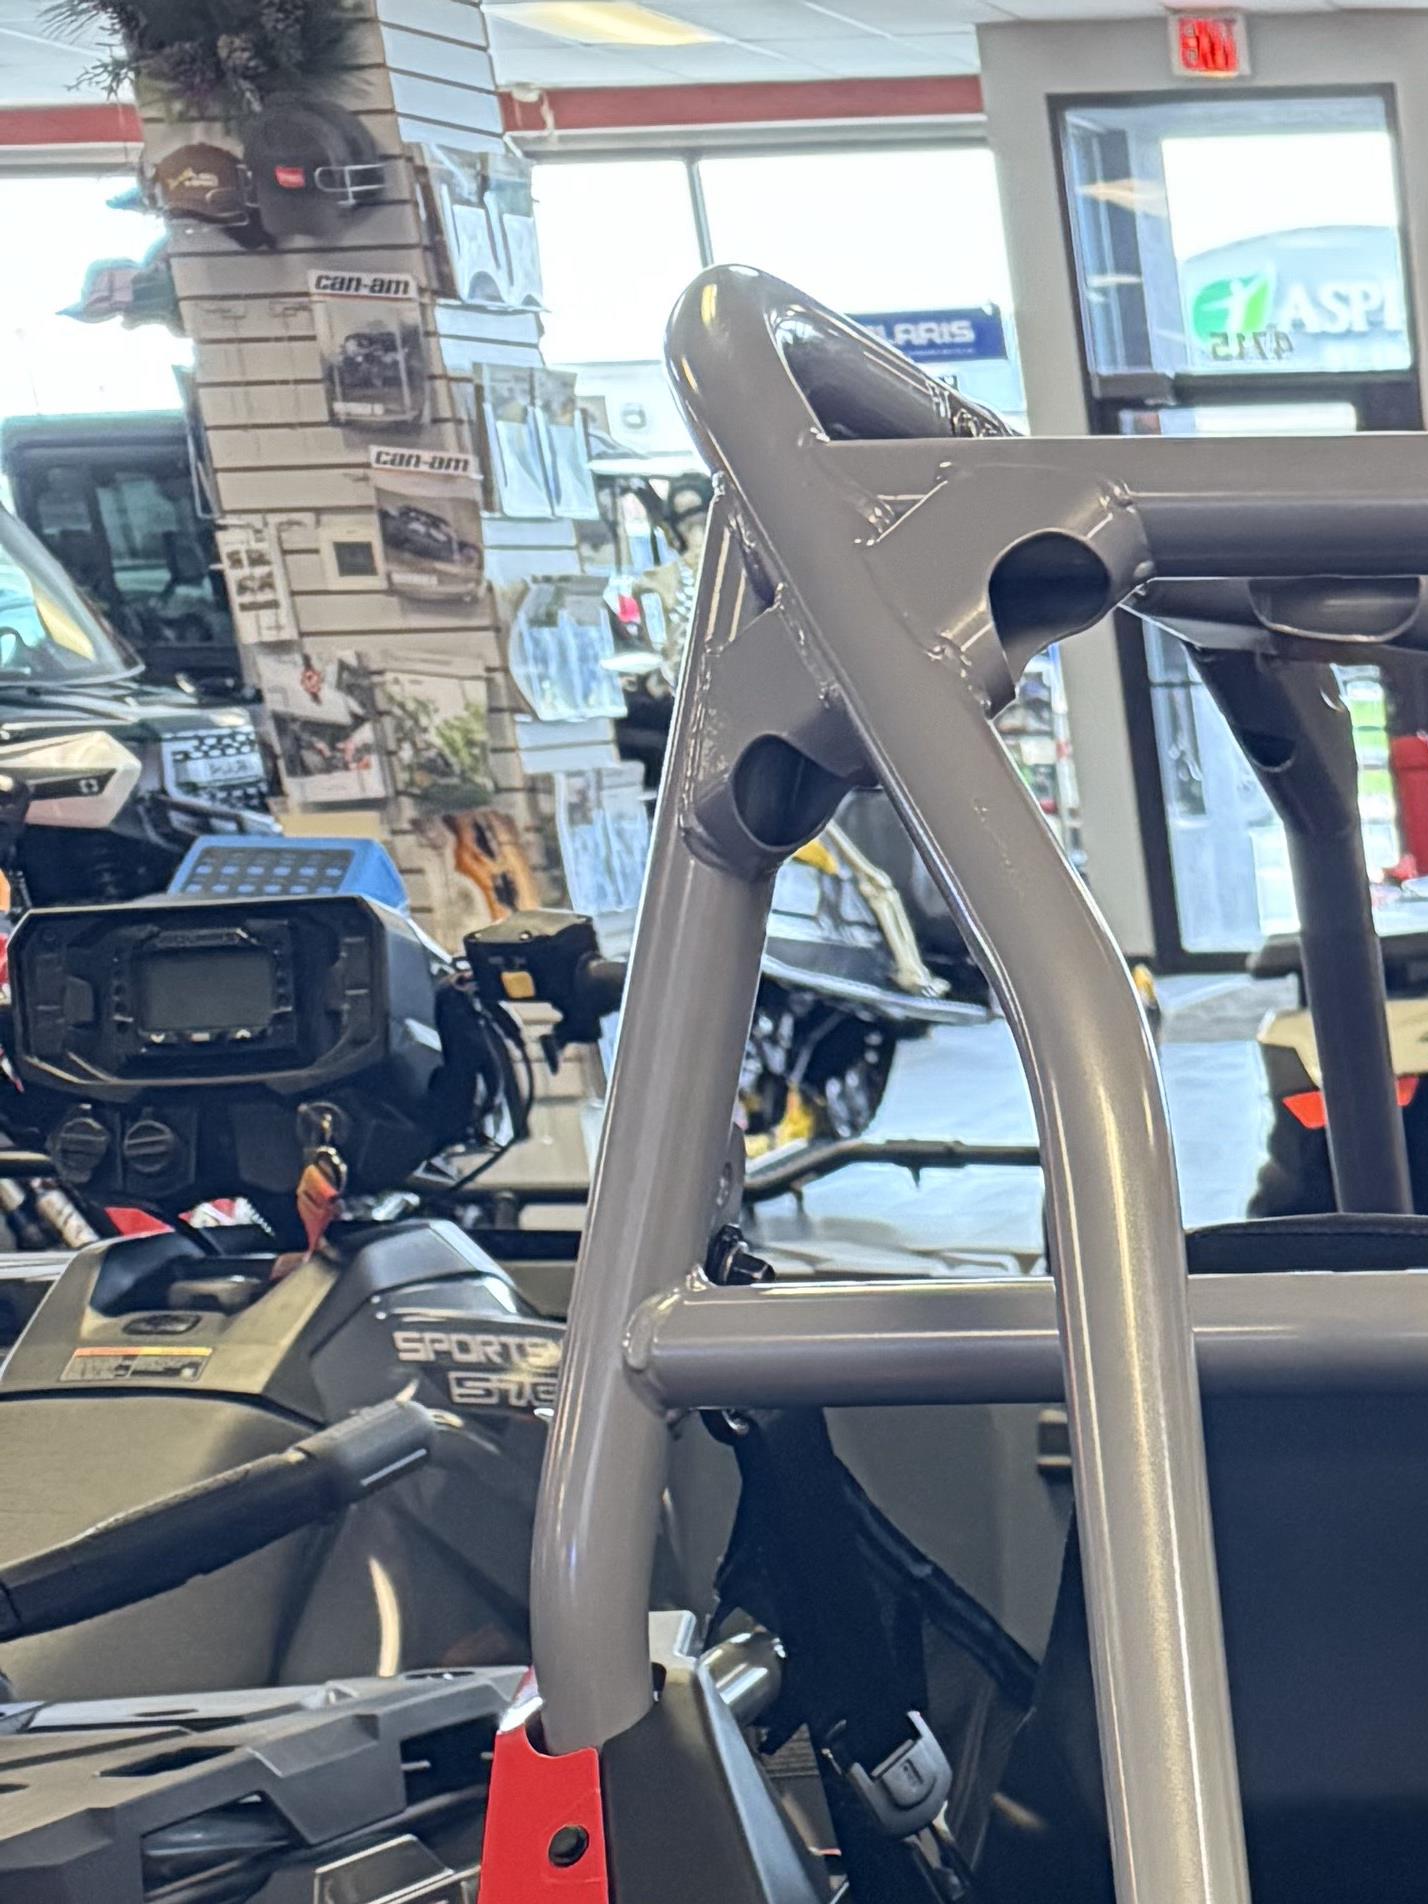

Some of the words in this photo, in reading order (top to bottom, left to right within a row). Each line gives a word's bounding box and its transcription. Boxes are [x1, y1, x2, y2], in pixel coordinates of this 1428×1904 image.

[314, 274, 410, 296] can-am
[867, 319, 976, 346] LARIS
[374, 450, 470, 473] can-am
